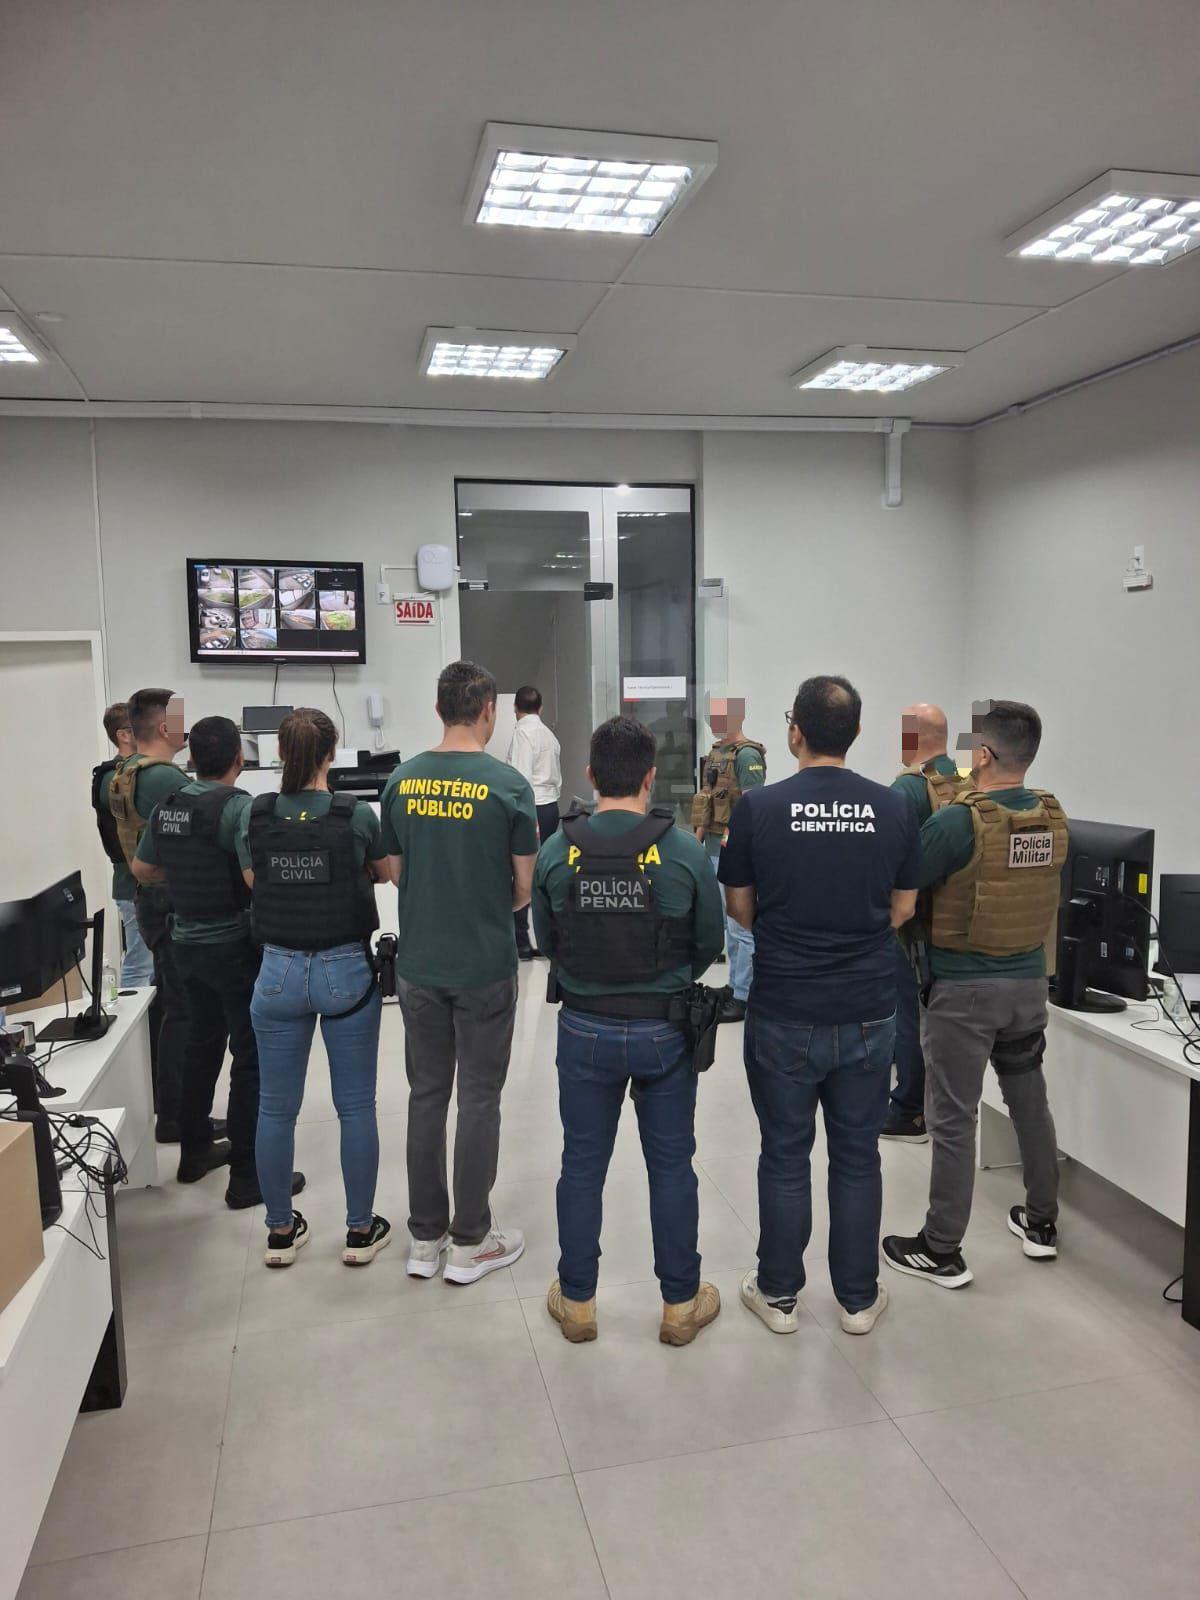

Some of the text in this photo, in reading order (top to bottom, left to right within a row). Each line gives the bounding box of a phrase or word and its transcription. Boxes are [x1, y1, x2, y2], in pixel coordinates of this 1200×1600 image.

[399, 778, 489, 801] MINISTÉRIO
[407, 796, 474, 820] PÚBLICO
[790, 801, 876, 818] POLÍCIA
[162, 822, 181, 833] CIVIL
[790, 820, 876, 833] CIENTÍFICA
[1012, 849, 1050, 864] Militar
[281, 869, 316, 880] CIVIL
[580, 877, 644, 896] POLÍCIA
[580, 896, 645, 908] PENAL
